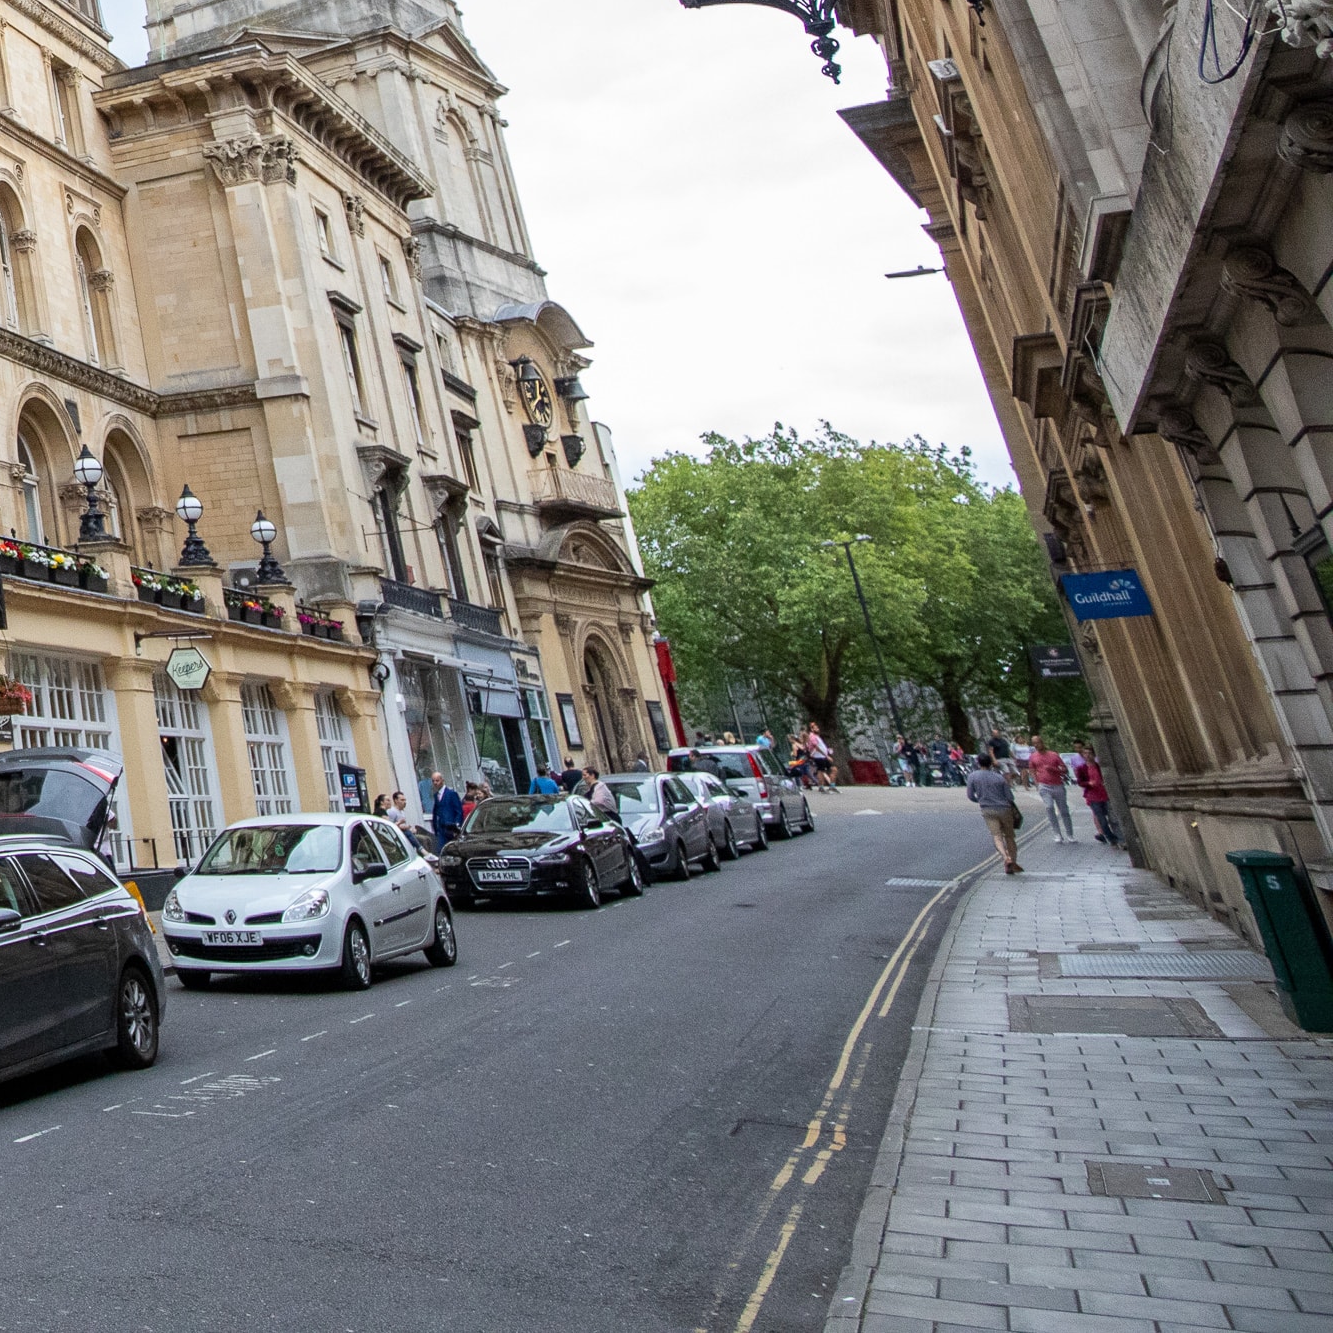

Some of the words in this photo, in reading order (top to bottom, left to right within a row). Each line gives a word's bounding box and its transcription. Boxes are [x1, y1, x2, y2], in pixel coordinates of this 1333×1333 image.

[1074, 590, 1131, 604] Guildhall
[172, 660, 203, 678] Keepers
[503, 872, 519, 880] KHL
[206, 932, 234, 943] WF06
[235, 932, 257, 943] XJE
